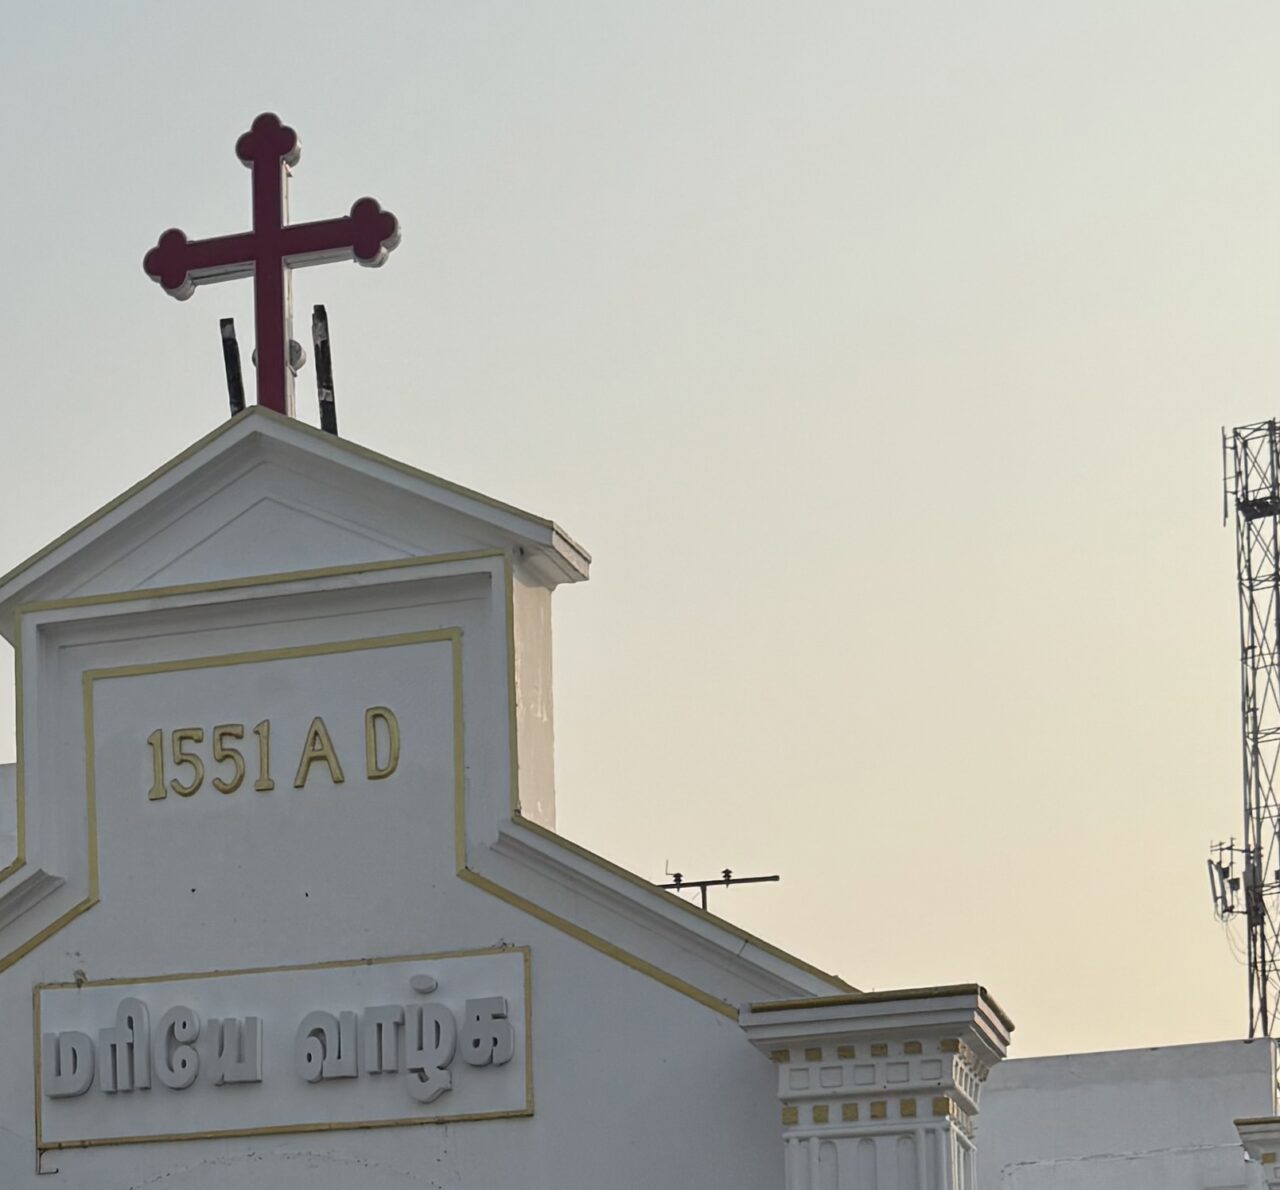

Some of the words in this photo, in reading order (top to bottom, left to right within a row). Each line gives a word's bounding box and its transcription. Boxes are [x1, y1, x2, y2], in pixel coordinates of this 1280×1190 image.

[147, 718, 275, 801] 1551
[43, 996, 263, 1099] மரியே
[294, 973, 515, 1104] வாழ்க
